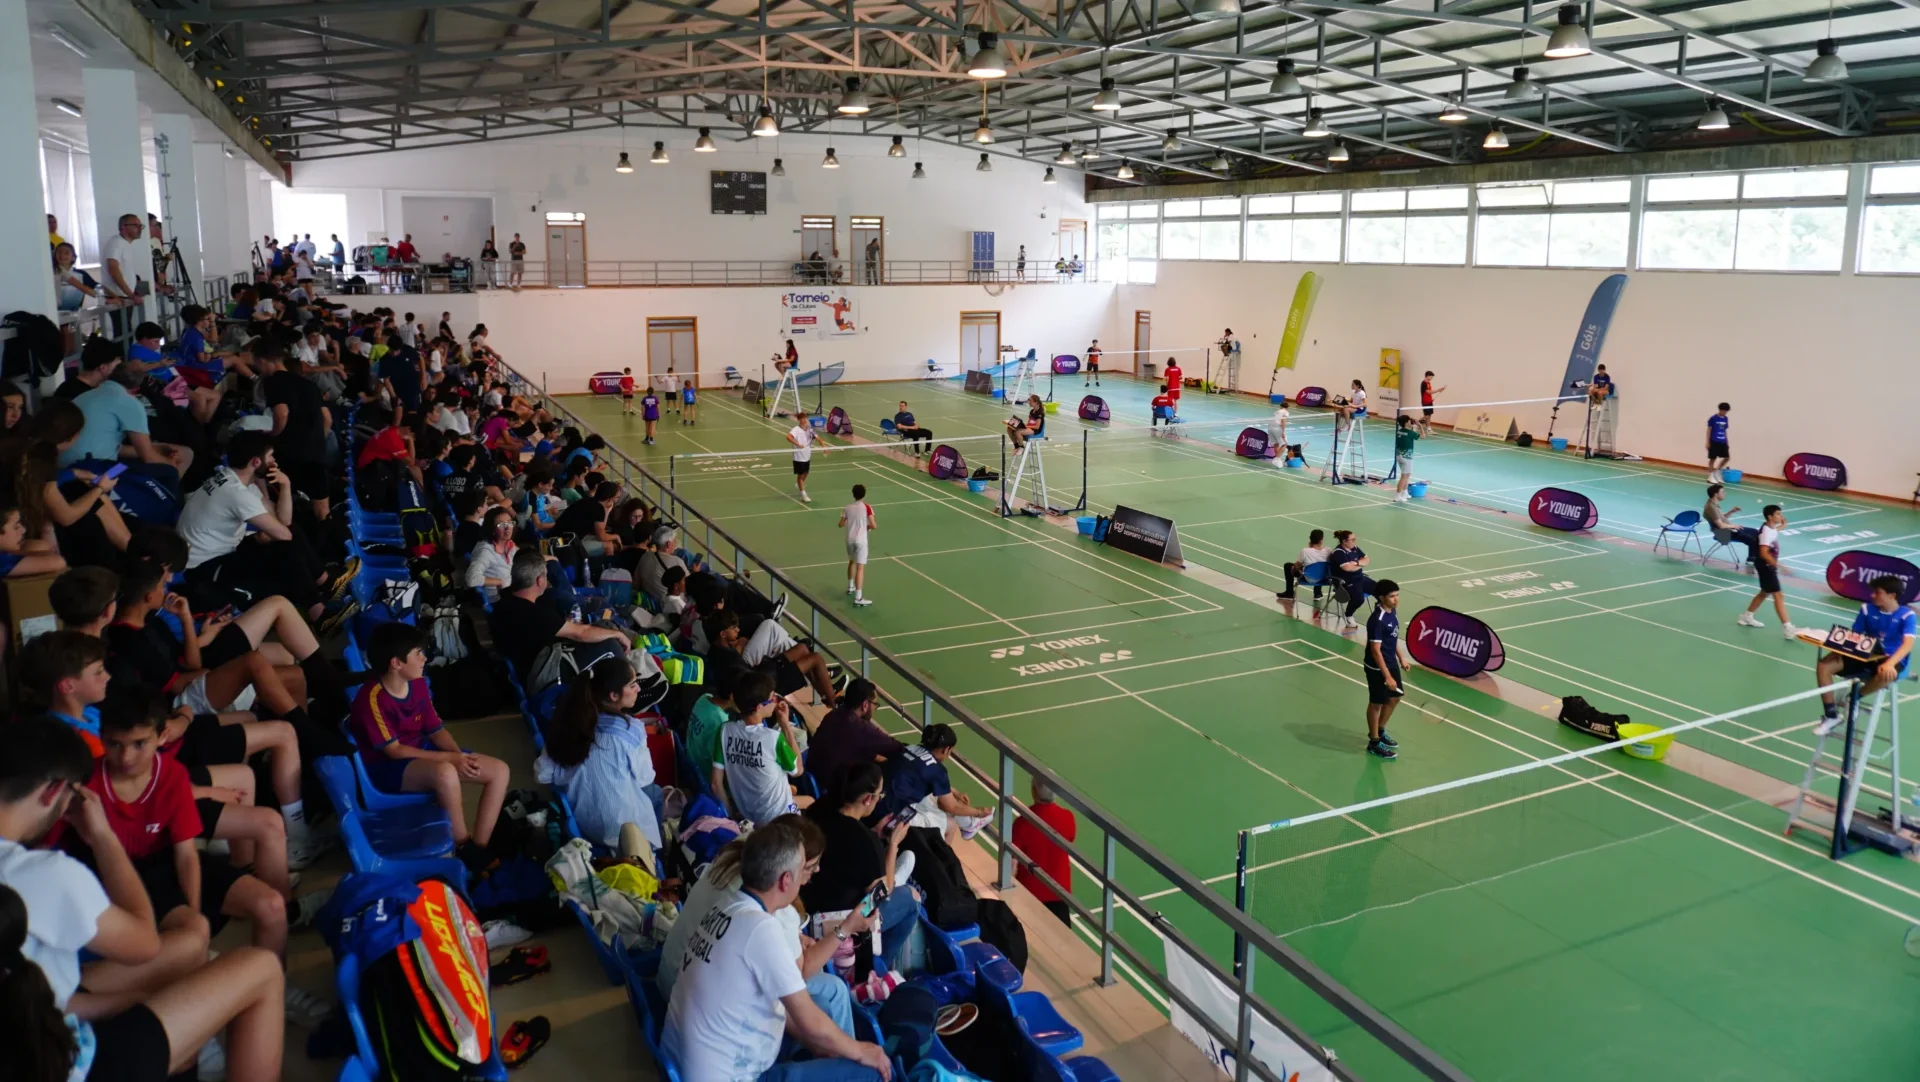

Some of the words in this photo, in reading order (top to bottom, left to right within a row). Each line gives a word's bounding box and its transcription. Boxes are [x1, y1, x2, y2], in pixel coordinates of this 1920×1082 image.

[789, 292, 830, 303] Torneio
[1581, 324, 1597, 350] Góis
[1062, 360, 1078, 368] YOUNG
[1306, 392, 1324, 401] YOUNG
[1247, 437, 1264, 450] YOUNG
[1805, 464, 1837, 479] YOUNG
[1549, 500, 1582, 519] YOUNG
[1858, 566, 1909, 588] YOG
[1030, 634, 1110, 651] YONEX
[1434, 626, 1479, 658] YOUNG
[1009, 657, 1095, 676] YONEX
[1590, 722, 1611, 734] YOUNG
[726, 753, 765, 768] PORTUGAL
